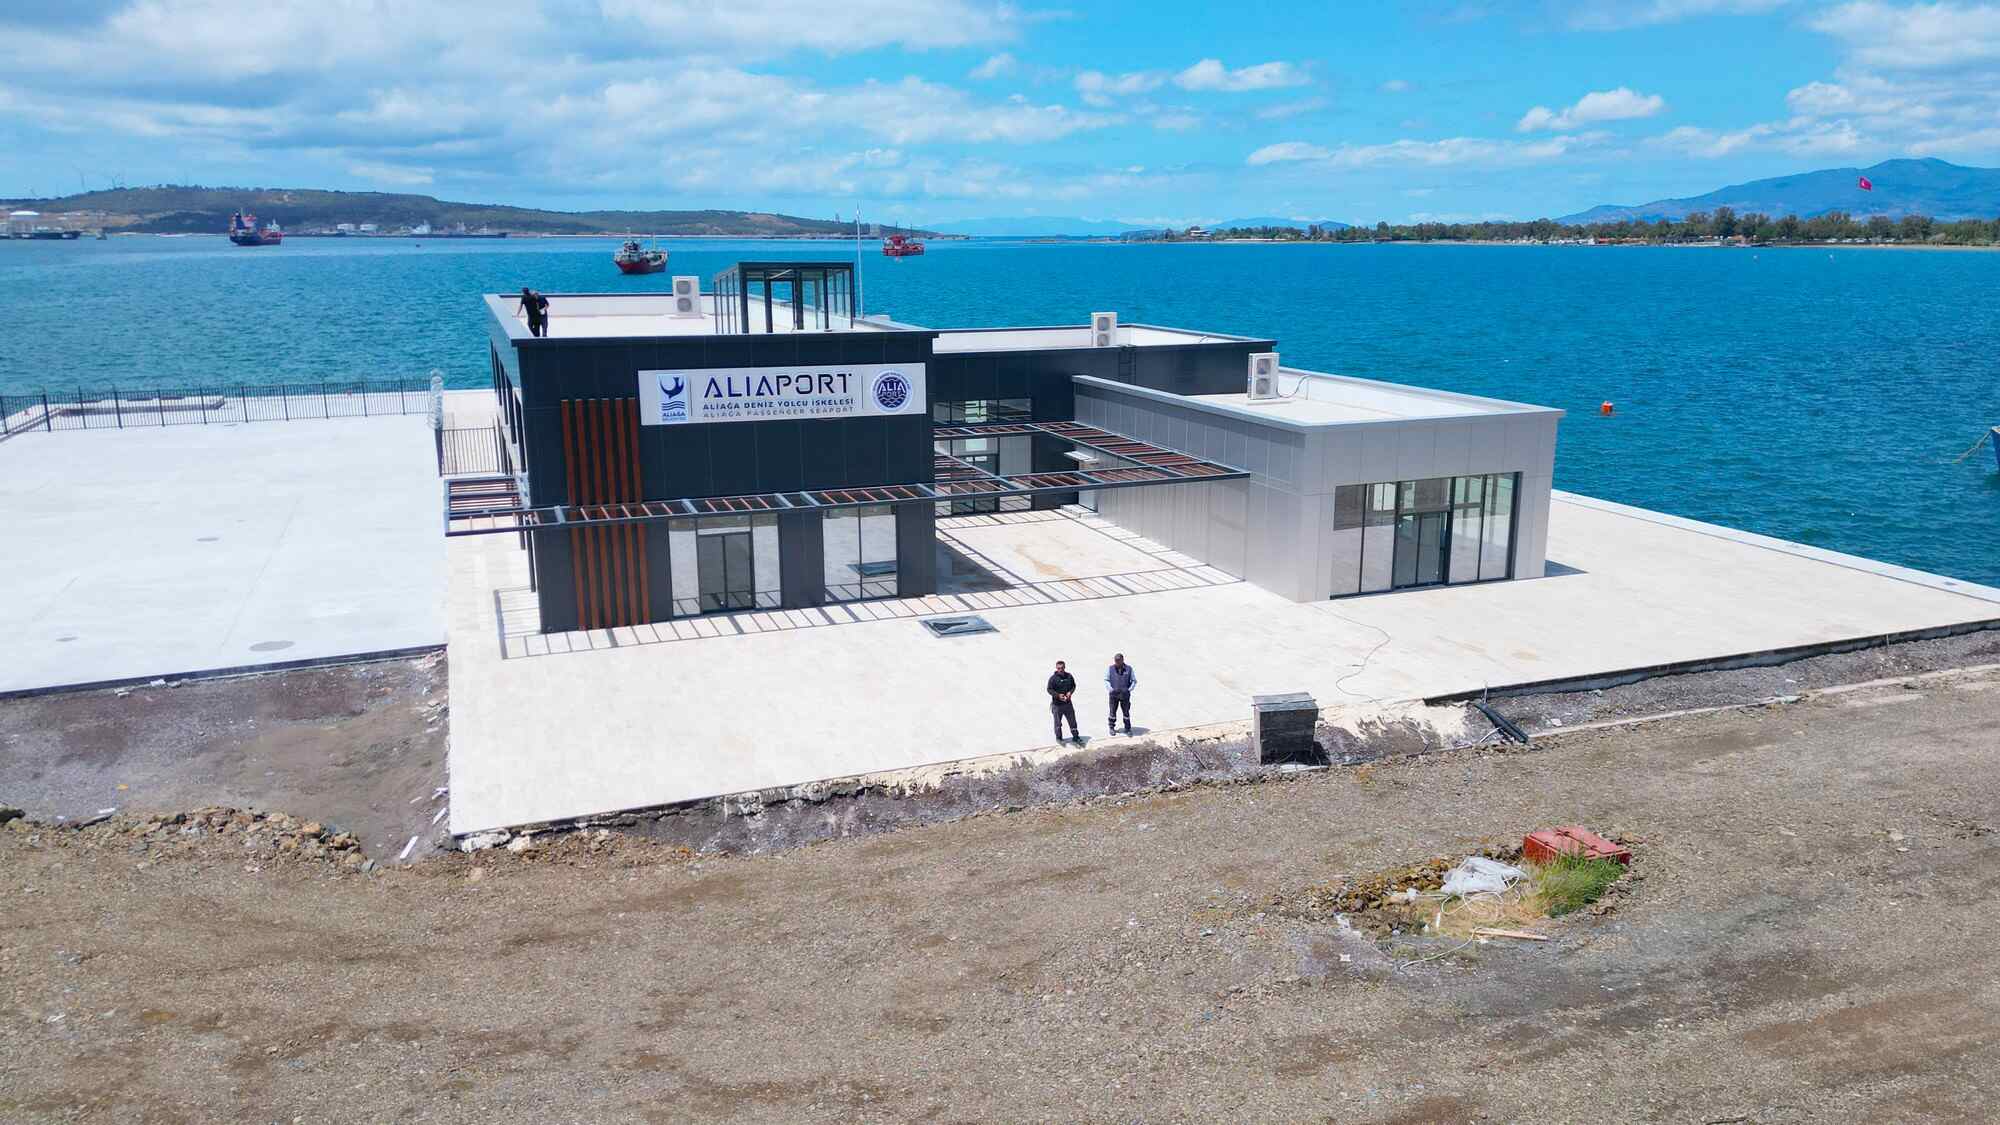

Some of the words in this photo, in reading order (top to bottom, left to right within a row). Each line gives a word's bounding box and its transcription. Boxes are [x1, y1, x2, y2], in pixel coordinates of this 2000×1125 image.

[704, 373, 853, 398] ALIAPORT
[878, 382, 906, 394] ALIA
[744, 400, 774, 409] DENİZ
[777, 400, 808, 408] YOLCU
[809, 406, 854, 415] SEAPORT
